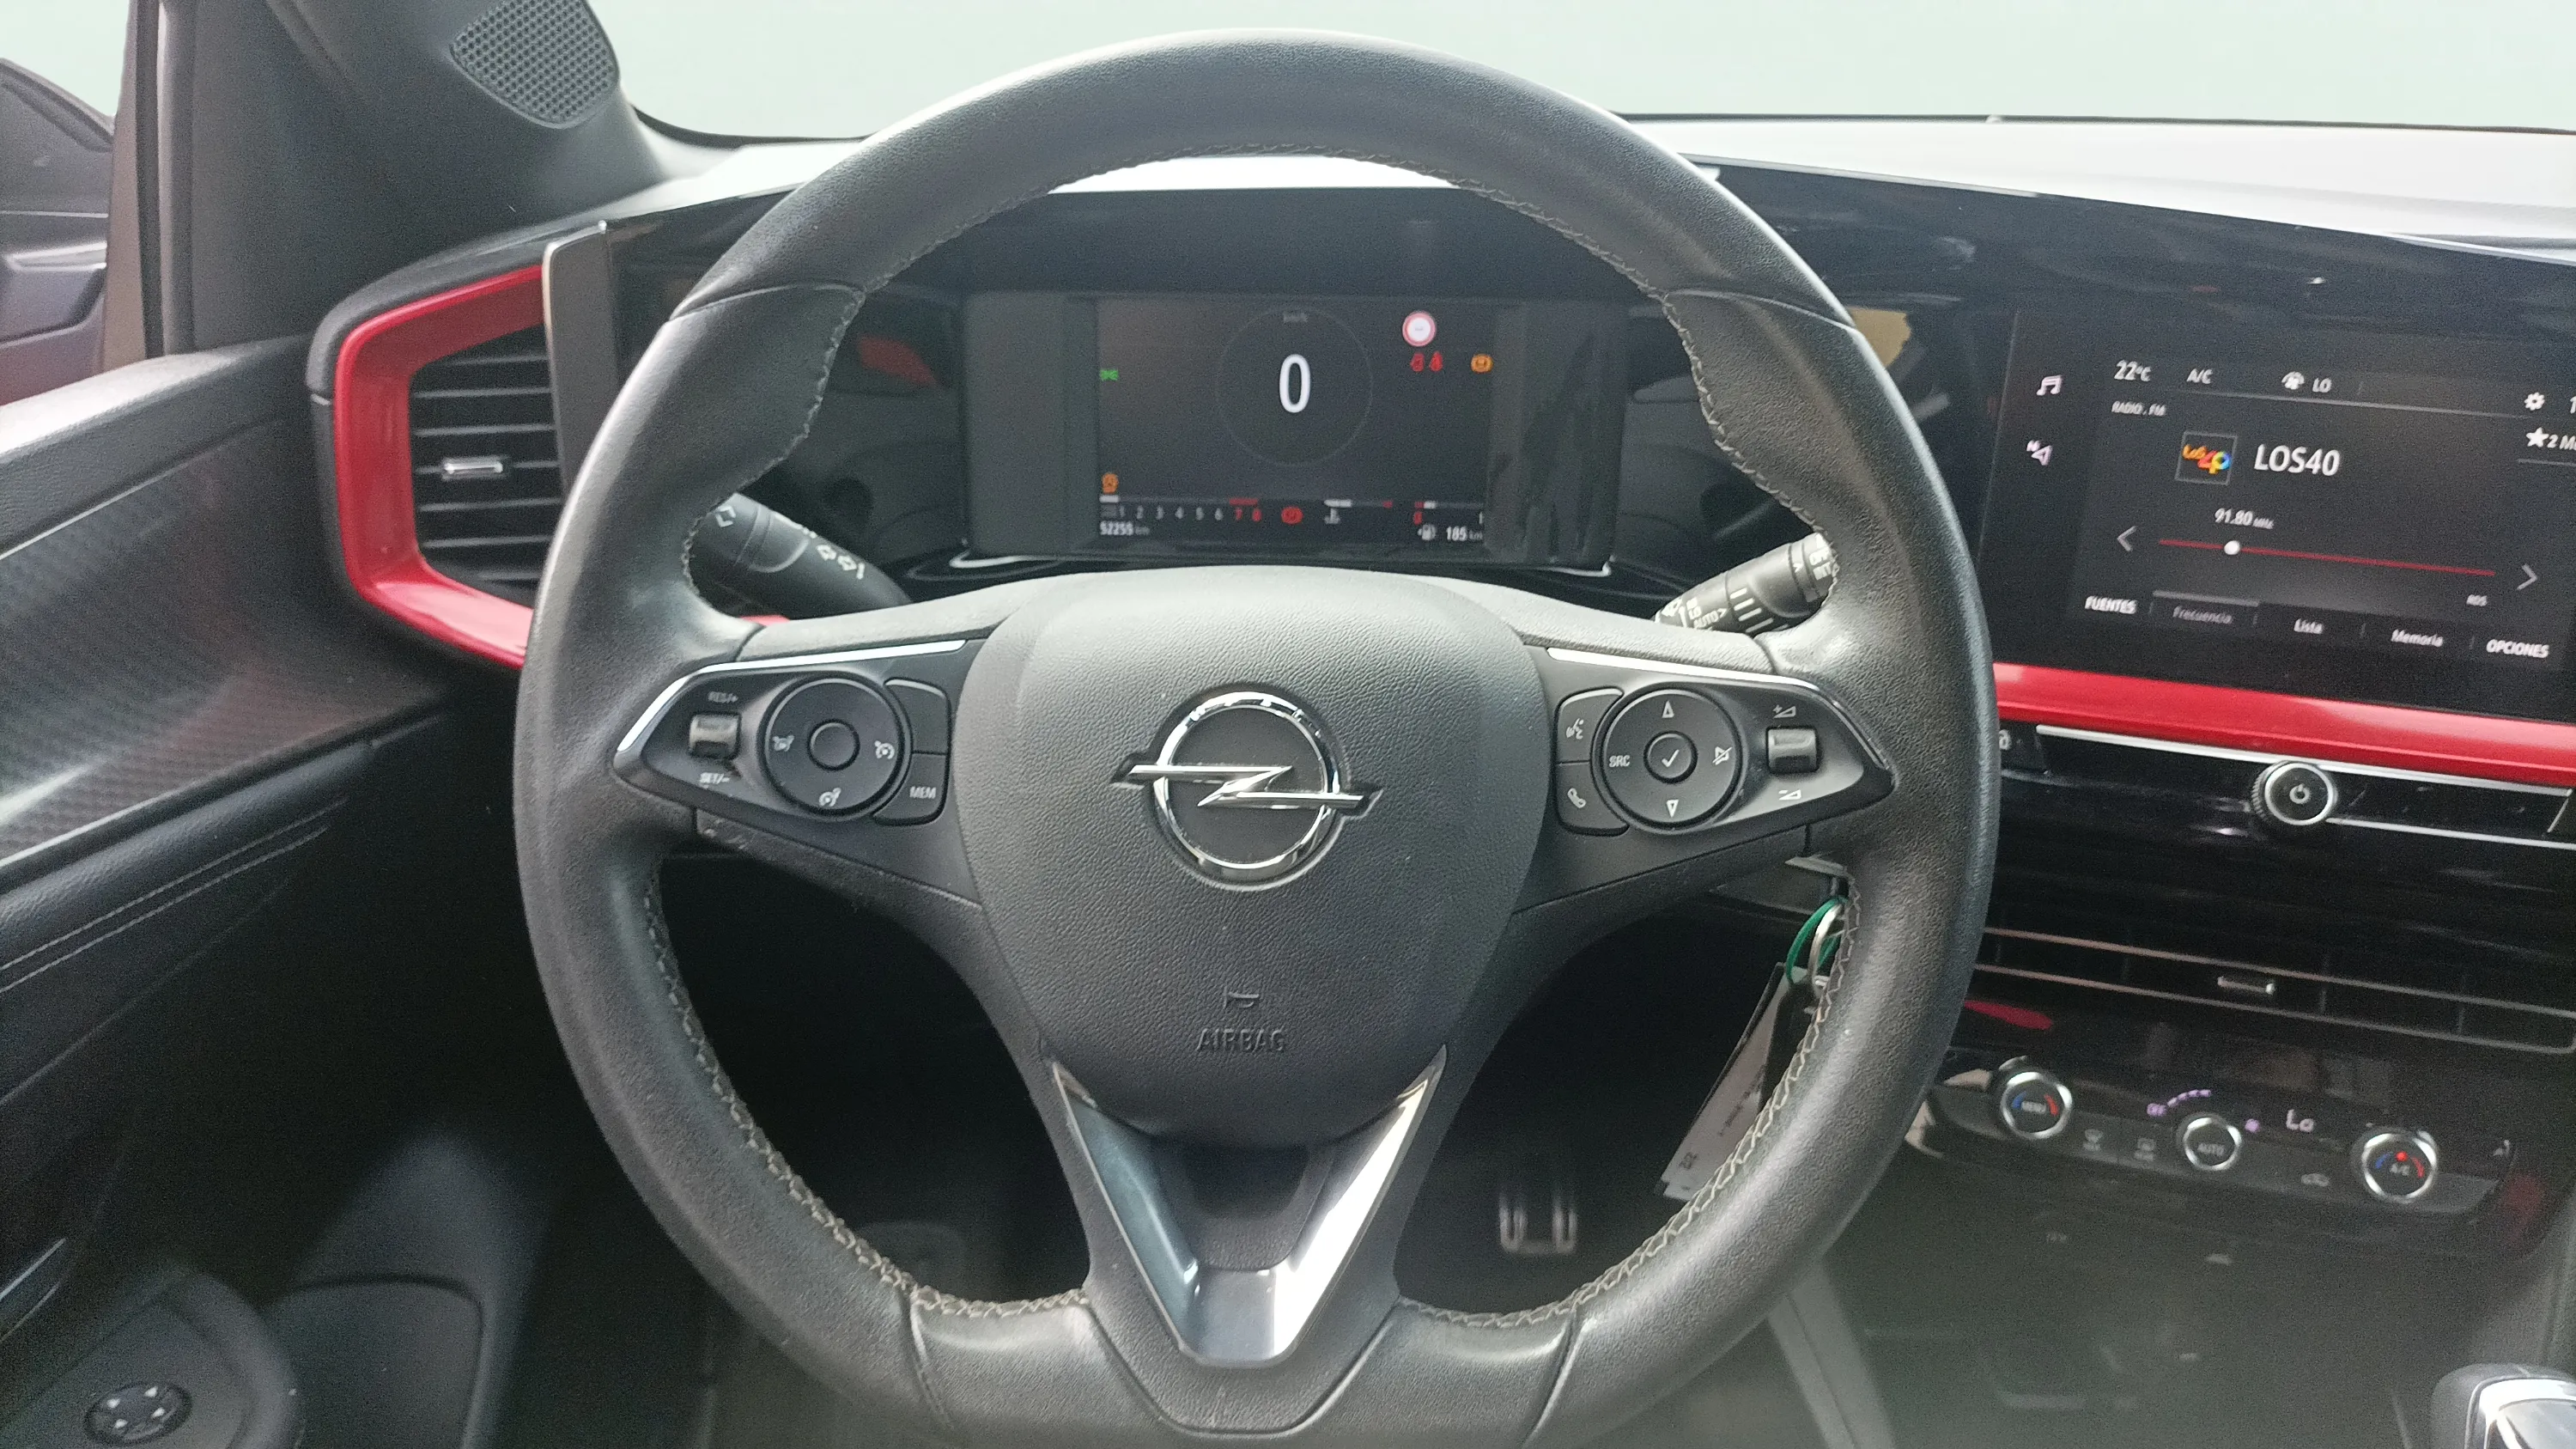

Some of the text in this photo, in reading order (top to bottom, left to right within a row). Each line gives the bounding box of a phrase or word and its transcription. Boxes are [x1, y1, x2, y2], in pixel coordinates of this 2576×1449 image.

[1279, 354, 1311, 413] 0
[2186, 368, 2214, 385] A/C
[2312, 377, 2333, 393] LO
[2253, 443, 2341, 477] LOS40
[2215, 507, 2254, 527] 91.80
[2085, 594, 2137, 615] FUENTES
[2172, 605, 2233, 624] Frecuencia
[2293, 618, 2324, 635] Lista
[2391, 629, 2445, 648] Memoria
[2486, 638, 2550, 659] OPCIONES
[1608, 754, 1631, 768] SRC
[909, 784, 937, 800] MEM
[1196, 1027, 1285, 1052] AIRBAG
